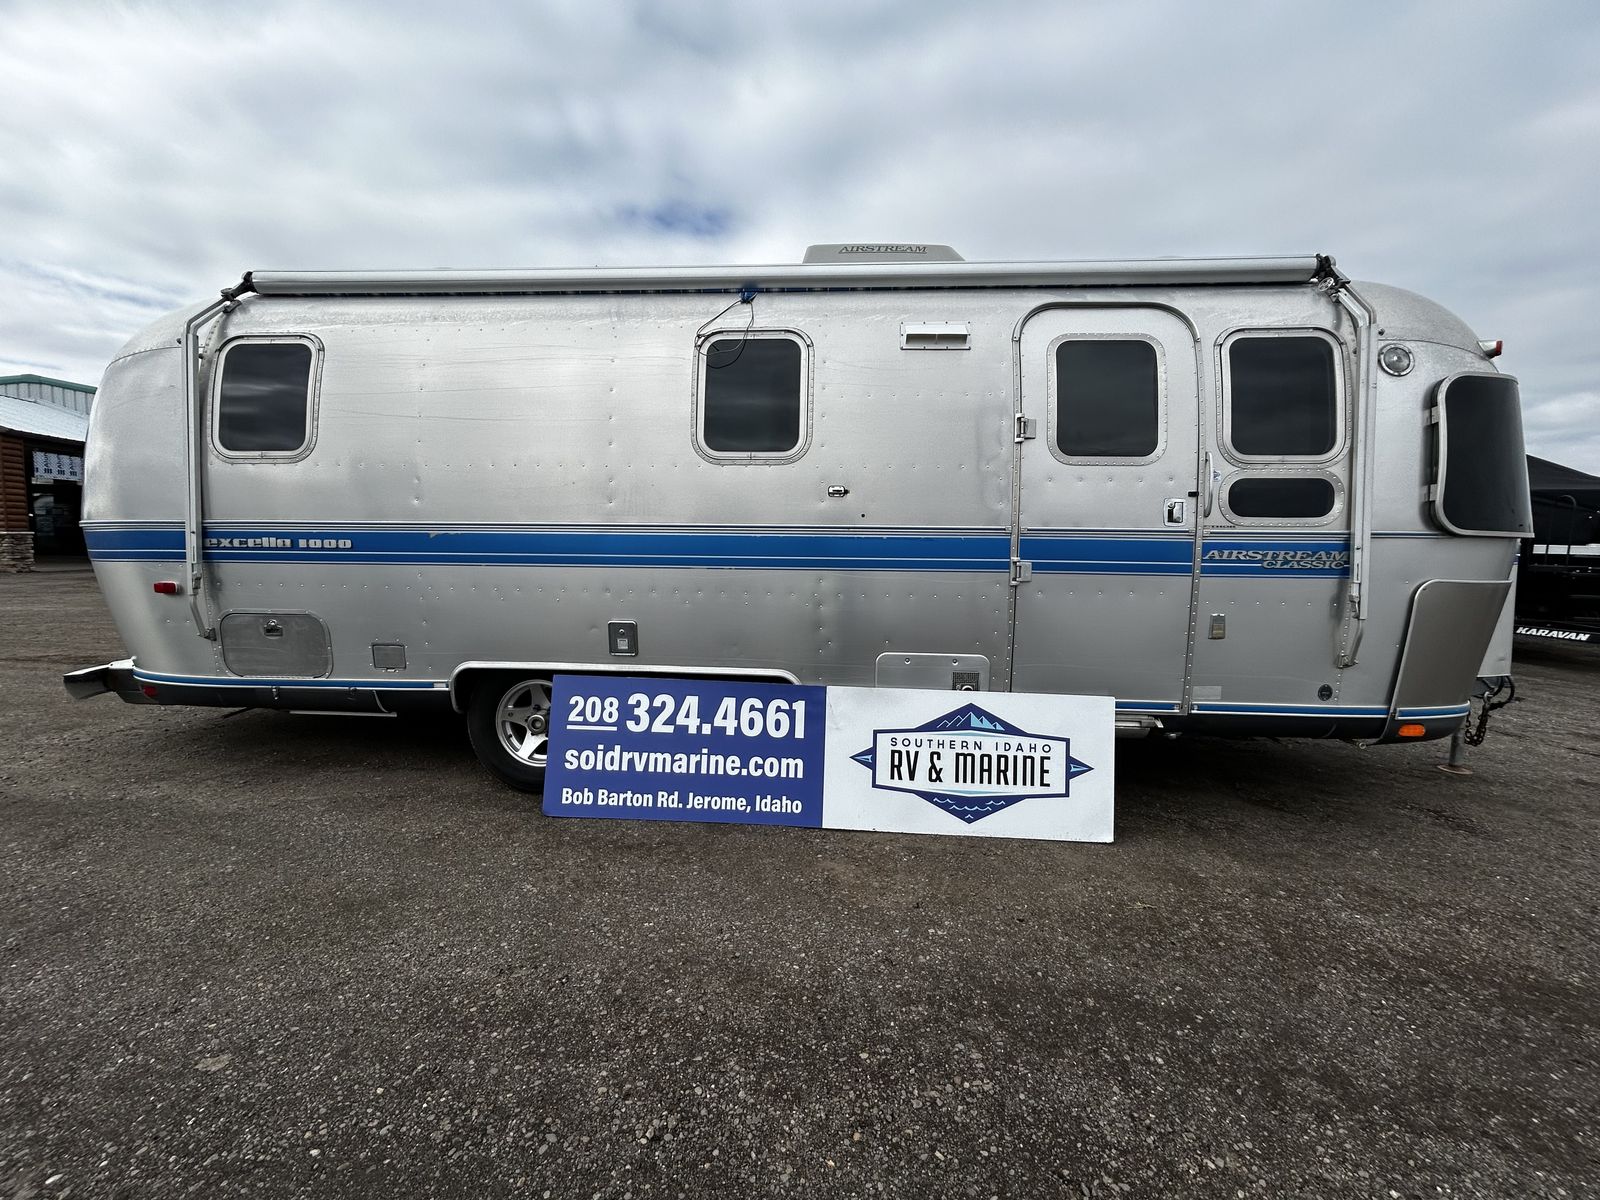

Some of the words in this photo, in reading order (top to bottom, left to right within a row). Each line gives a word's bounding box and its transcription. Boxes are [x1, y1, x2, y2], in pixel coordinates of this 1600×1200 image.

[838, 245, 928, 254] AIRSTREAM
[204, 537, 292, 548] excella
[299, 538, 352, 548] 1000
[1203, 549, 1349, 561] AIRSTREAM
[1262, 560, 1346, 569] CLASSIC
[1516, 627, 1591, 641] KARAVAN
[567, 695, 619, 724] 208
[625, 692, 806, 739] 324.4661
[890, 737, 983, 751] SOUTHERN
[995, 741, 1052, 754] IDAHO
[564, 744, 804, 779] soidrvmarine.com
[890, 749, 919, 781] RV
[928, 751, 943, 783] &
[954, 752, 1051, 787] MARINE
[561, 787, 594, 805] Bob
[598, 788, 653, 808] Barton
[657, 791, 683, 809] Rd.
[686, 792, 751, 814] Jerome,
[755, 795, 803, 814] Idaho
